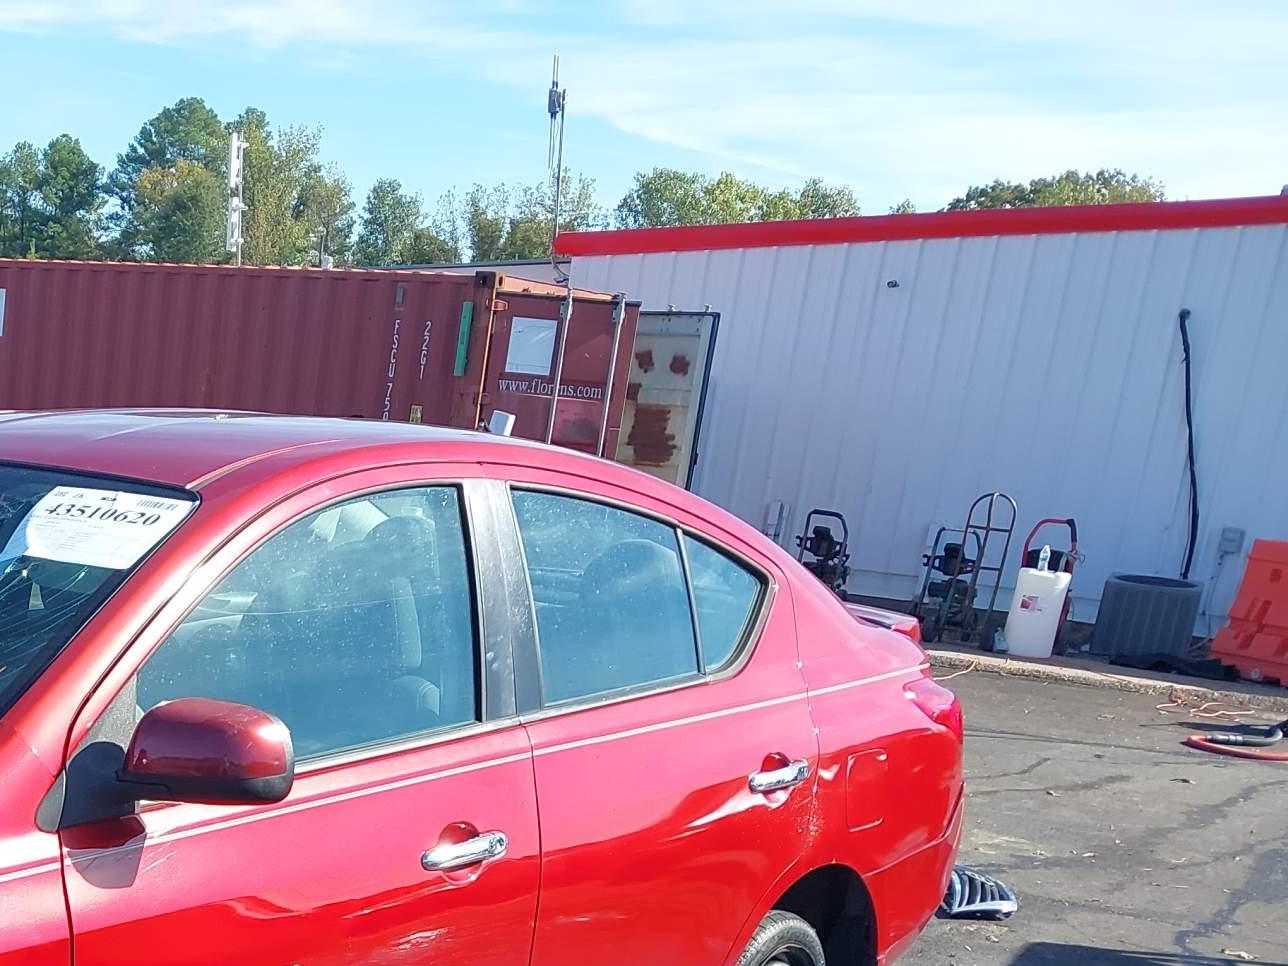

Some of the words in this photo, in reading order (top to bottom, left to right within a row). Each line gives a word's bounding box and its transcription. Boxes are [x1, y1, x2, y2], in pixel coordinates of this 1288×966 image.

[388, 319, 401, 378] FSCU
[498, 377, 602, 399] www.florns.com
[44, 502, 161, 526] 43510620
